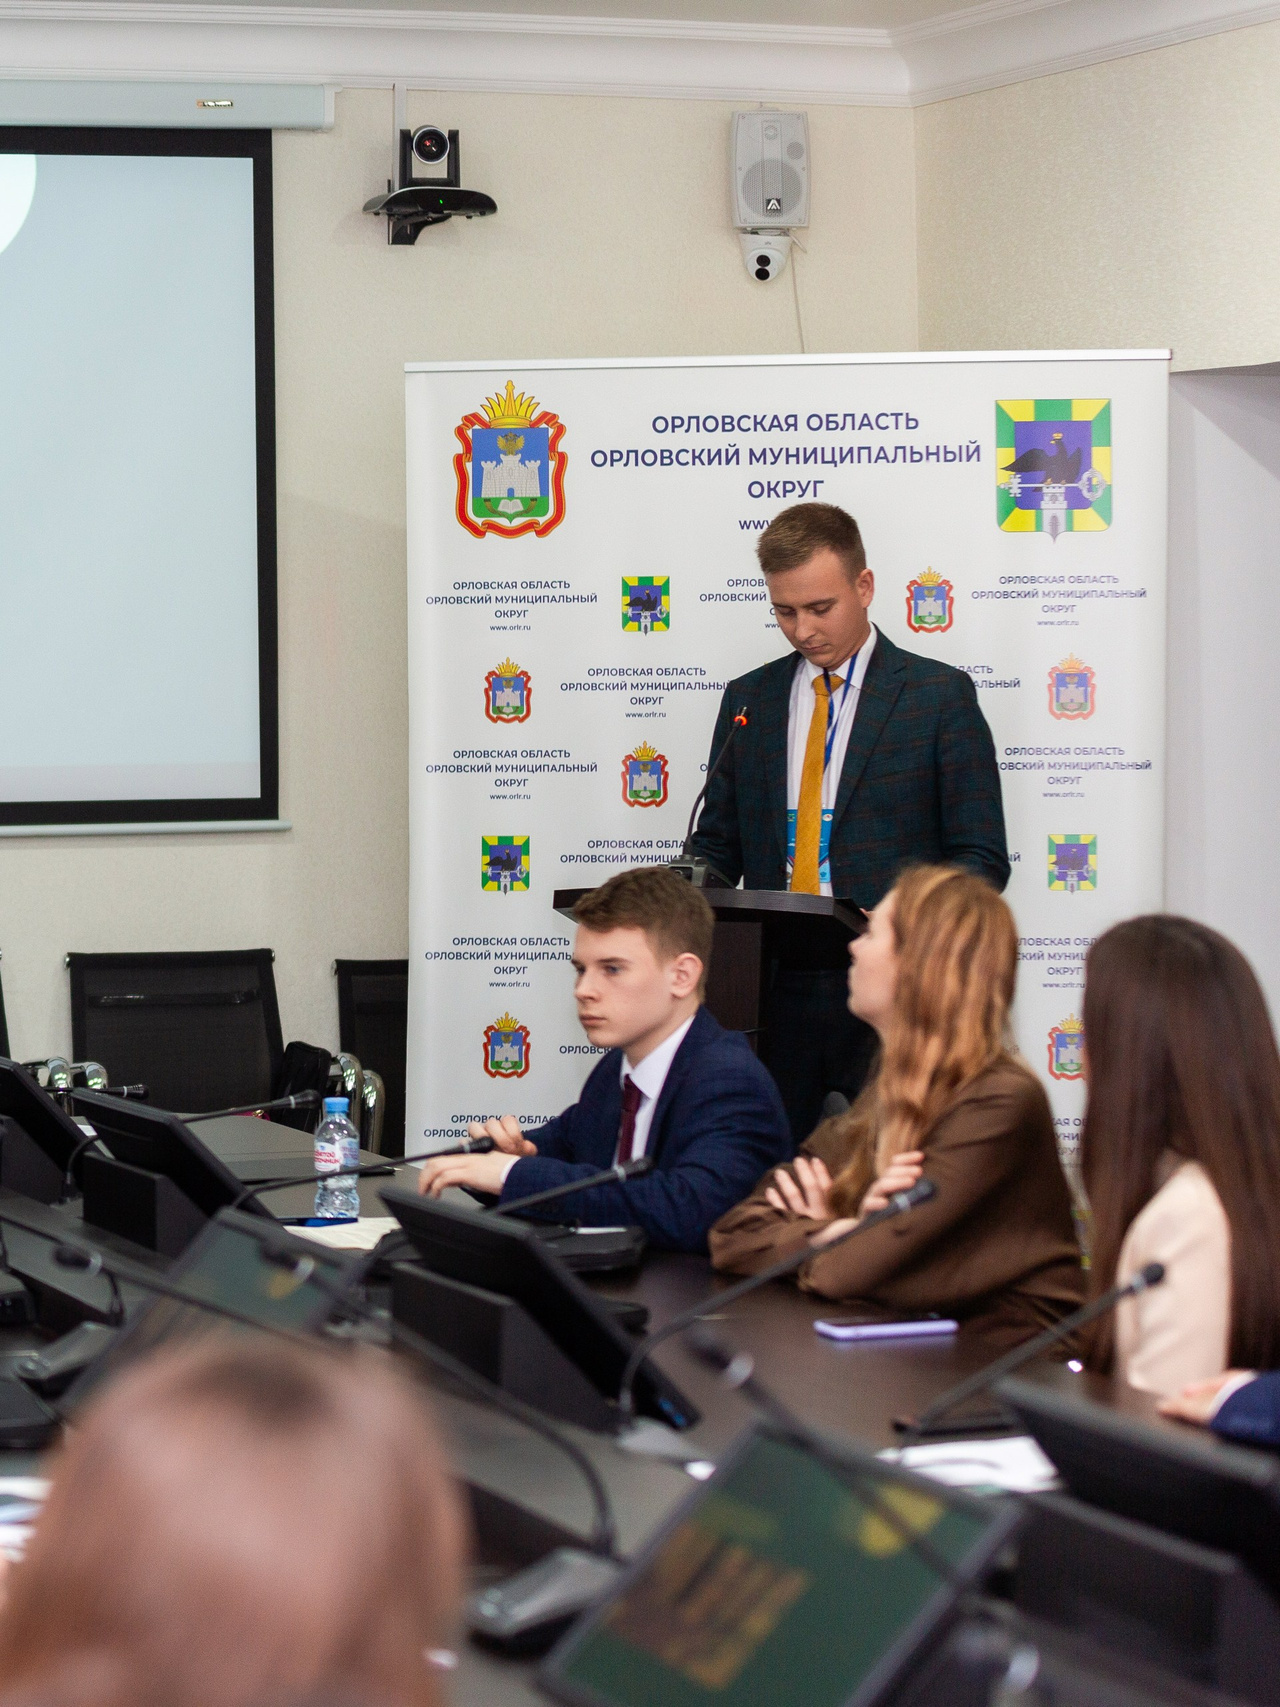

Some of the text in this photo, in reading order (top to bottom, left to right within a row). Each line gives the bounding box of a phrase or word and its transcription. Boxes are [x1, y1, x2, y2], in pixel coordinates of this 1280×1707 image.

[652, 413, 918, 433] ОРЛОВСКАЯ ОБЛАСТЬ
[591, 440, 980, 467] ОРЛОВСКИЙ МУНИЦИПАЛЬНЫЙ
[748, 480, 824, 498] ОКРУГ
[452, 580, 571, 591] ОРЛОВСКАЯ ОБЛАСТЬ
[998, 575, 1120, 585] ОРЛОВСКАЯ ОБЛАСТЬ
[425, 593, 597, 605] ОРЛОВСКИЙ МУНИЦИПАЛЬНЫЙ
[699, 590, 767, 603] ОРЛОВСКИЙ
[970, 587, 1148, 600] ОРЛОВСКИЙ МУНИЦИПАЛЬНЫЙ
[494, 609, 529, 619] ОКРУГ
[1041, 604, 1078, 614] ОКРУГ
[490, 624, 531, 632] www.orlr.ru
[587, 667, 653, 677] ОРЛОВСКАЯ
[655, 667, 707, 677] ОБЛАСТЬ
[560, 680, 628, 692] ОРЛОВСКИЙ
[629, 696, 665, 706] ОКРУГ
[452, 749, 571, 759] ОРЛОВСКАЯ ОБЛАСТЬ
[1003, 746, 1126, 756] ОРЛОВСКАЯ ОБЛАСТЬ
[425, 761, 598, 774] ОРЛОВСКИЙ МУНИЦИПАЛЬНЫЙ
[1047, 759, 1153, 771] МУНИЦИПАЛЬНЫЙ
[494, 778, 529, 788] ОКРУГ
[1046, 776, 1083, 785] ОКРУГ
[587, 839, 654, 849] ОРЛОВСКАЯ
[559, 852, 627, 864] ОРЛОВСКИЙ
[452, 936, 571, 947] ОРЛОВСКАЯ ОБЛАСТЬ
[424, 949, 491, 961] ОРЛОВСКИЙ
[493, 965, 529, 975] ОКРУГ
[1046, 965, 1083, 977] ОКРУГ
